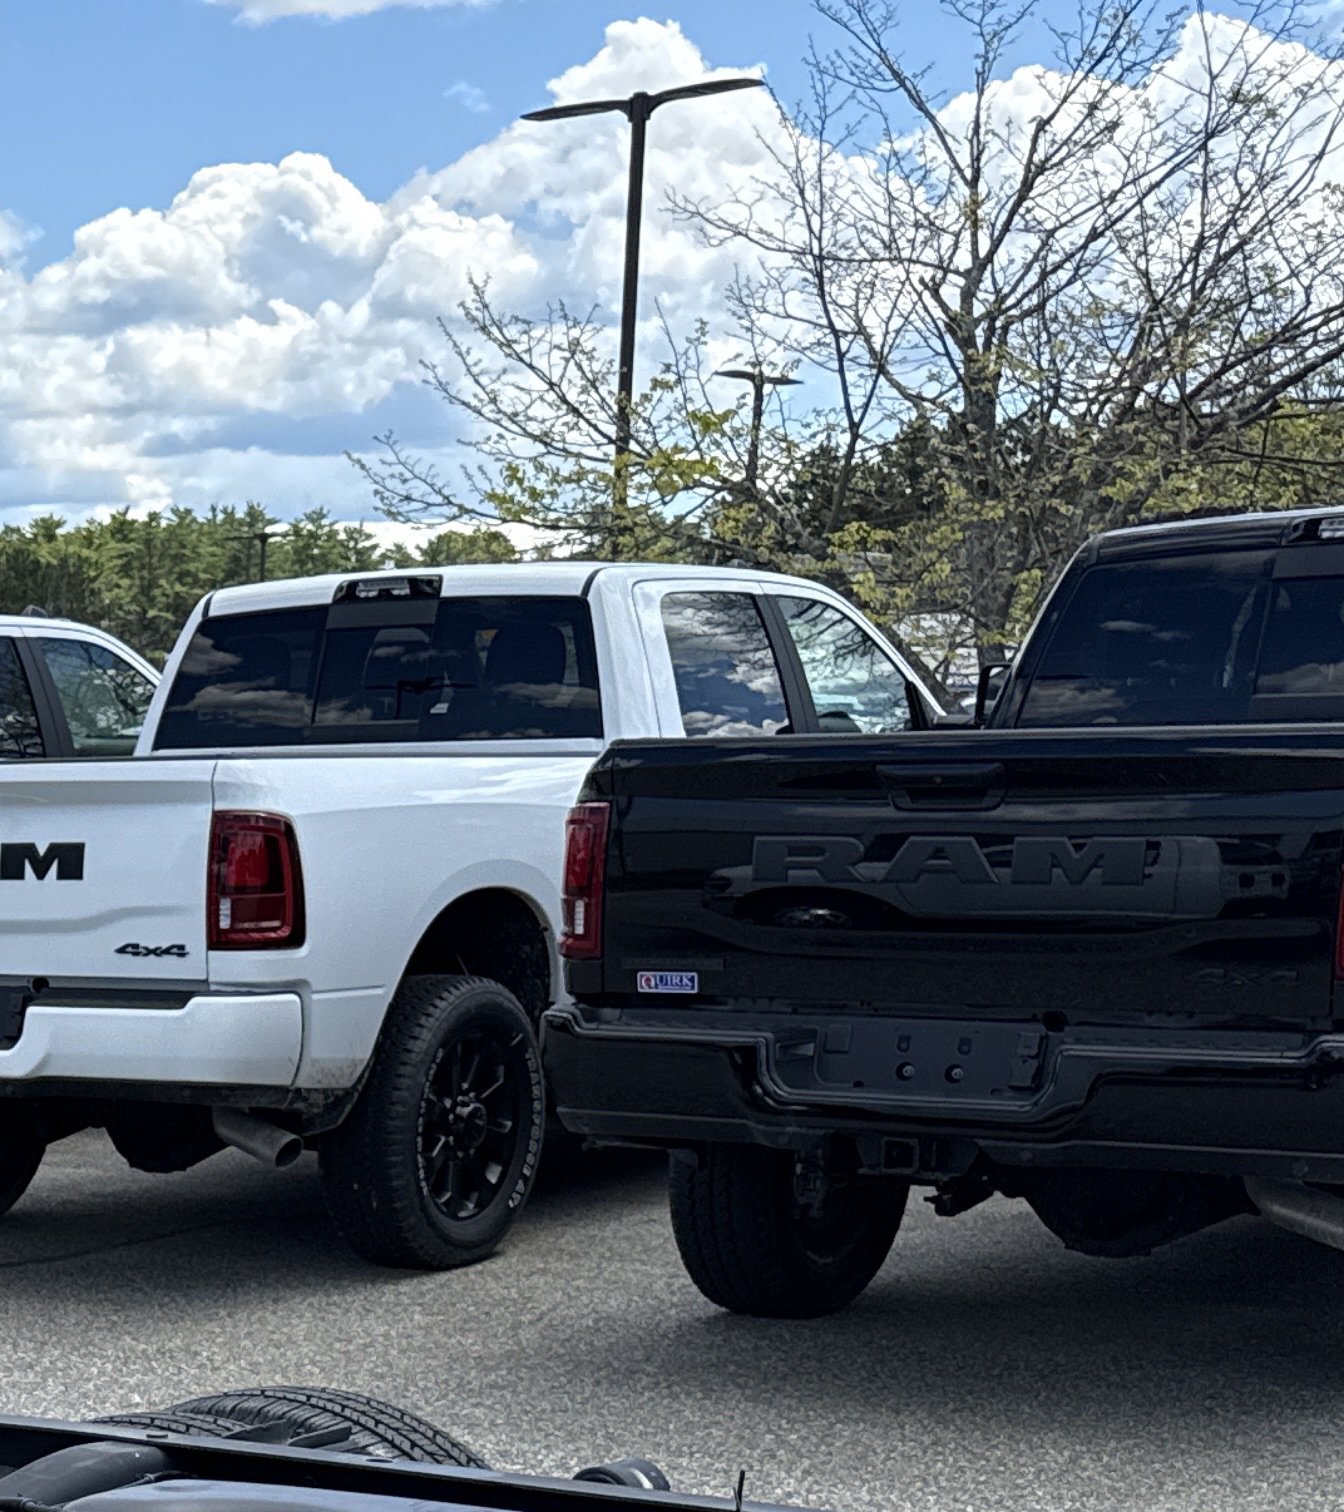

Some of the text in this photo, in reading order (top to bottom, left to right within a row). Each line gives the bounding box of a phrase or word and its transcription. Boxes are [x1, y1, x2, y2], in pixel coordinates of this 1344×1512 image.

[752, 835, 1146, 886] RAM
[114, 942, 190, 958] 4x4
[642, 974, 692, 989] QUIRK
